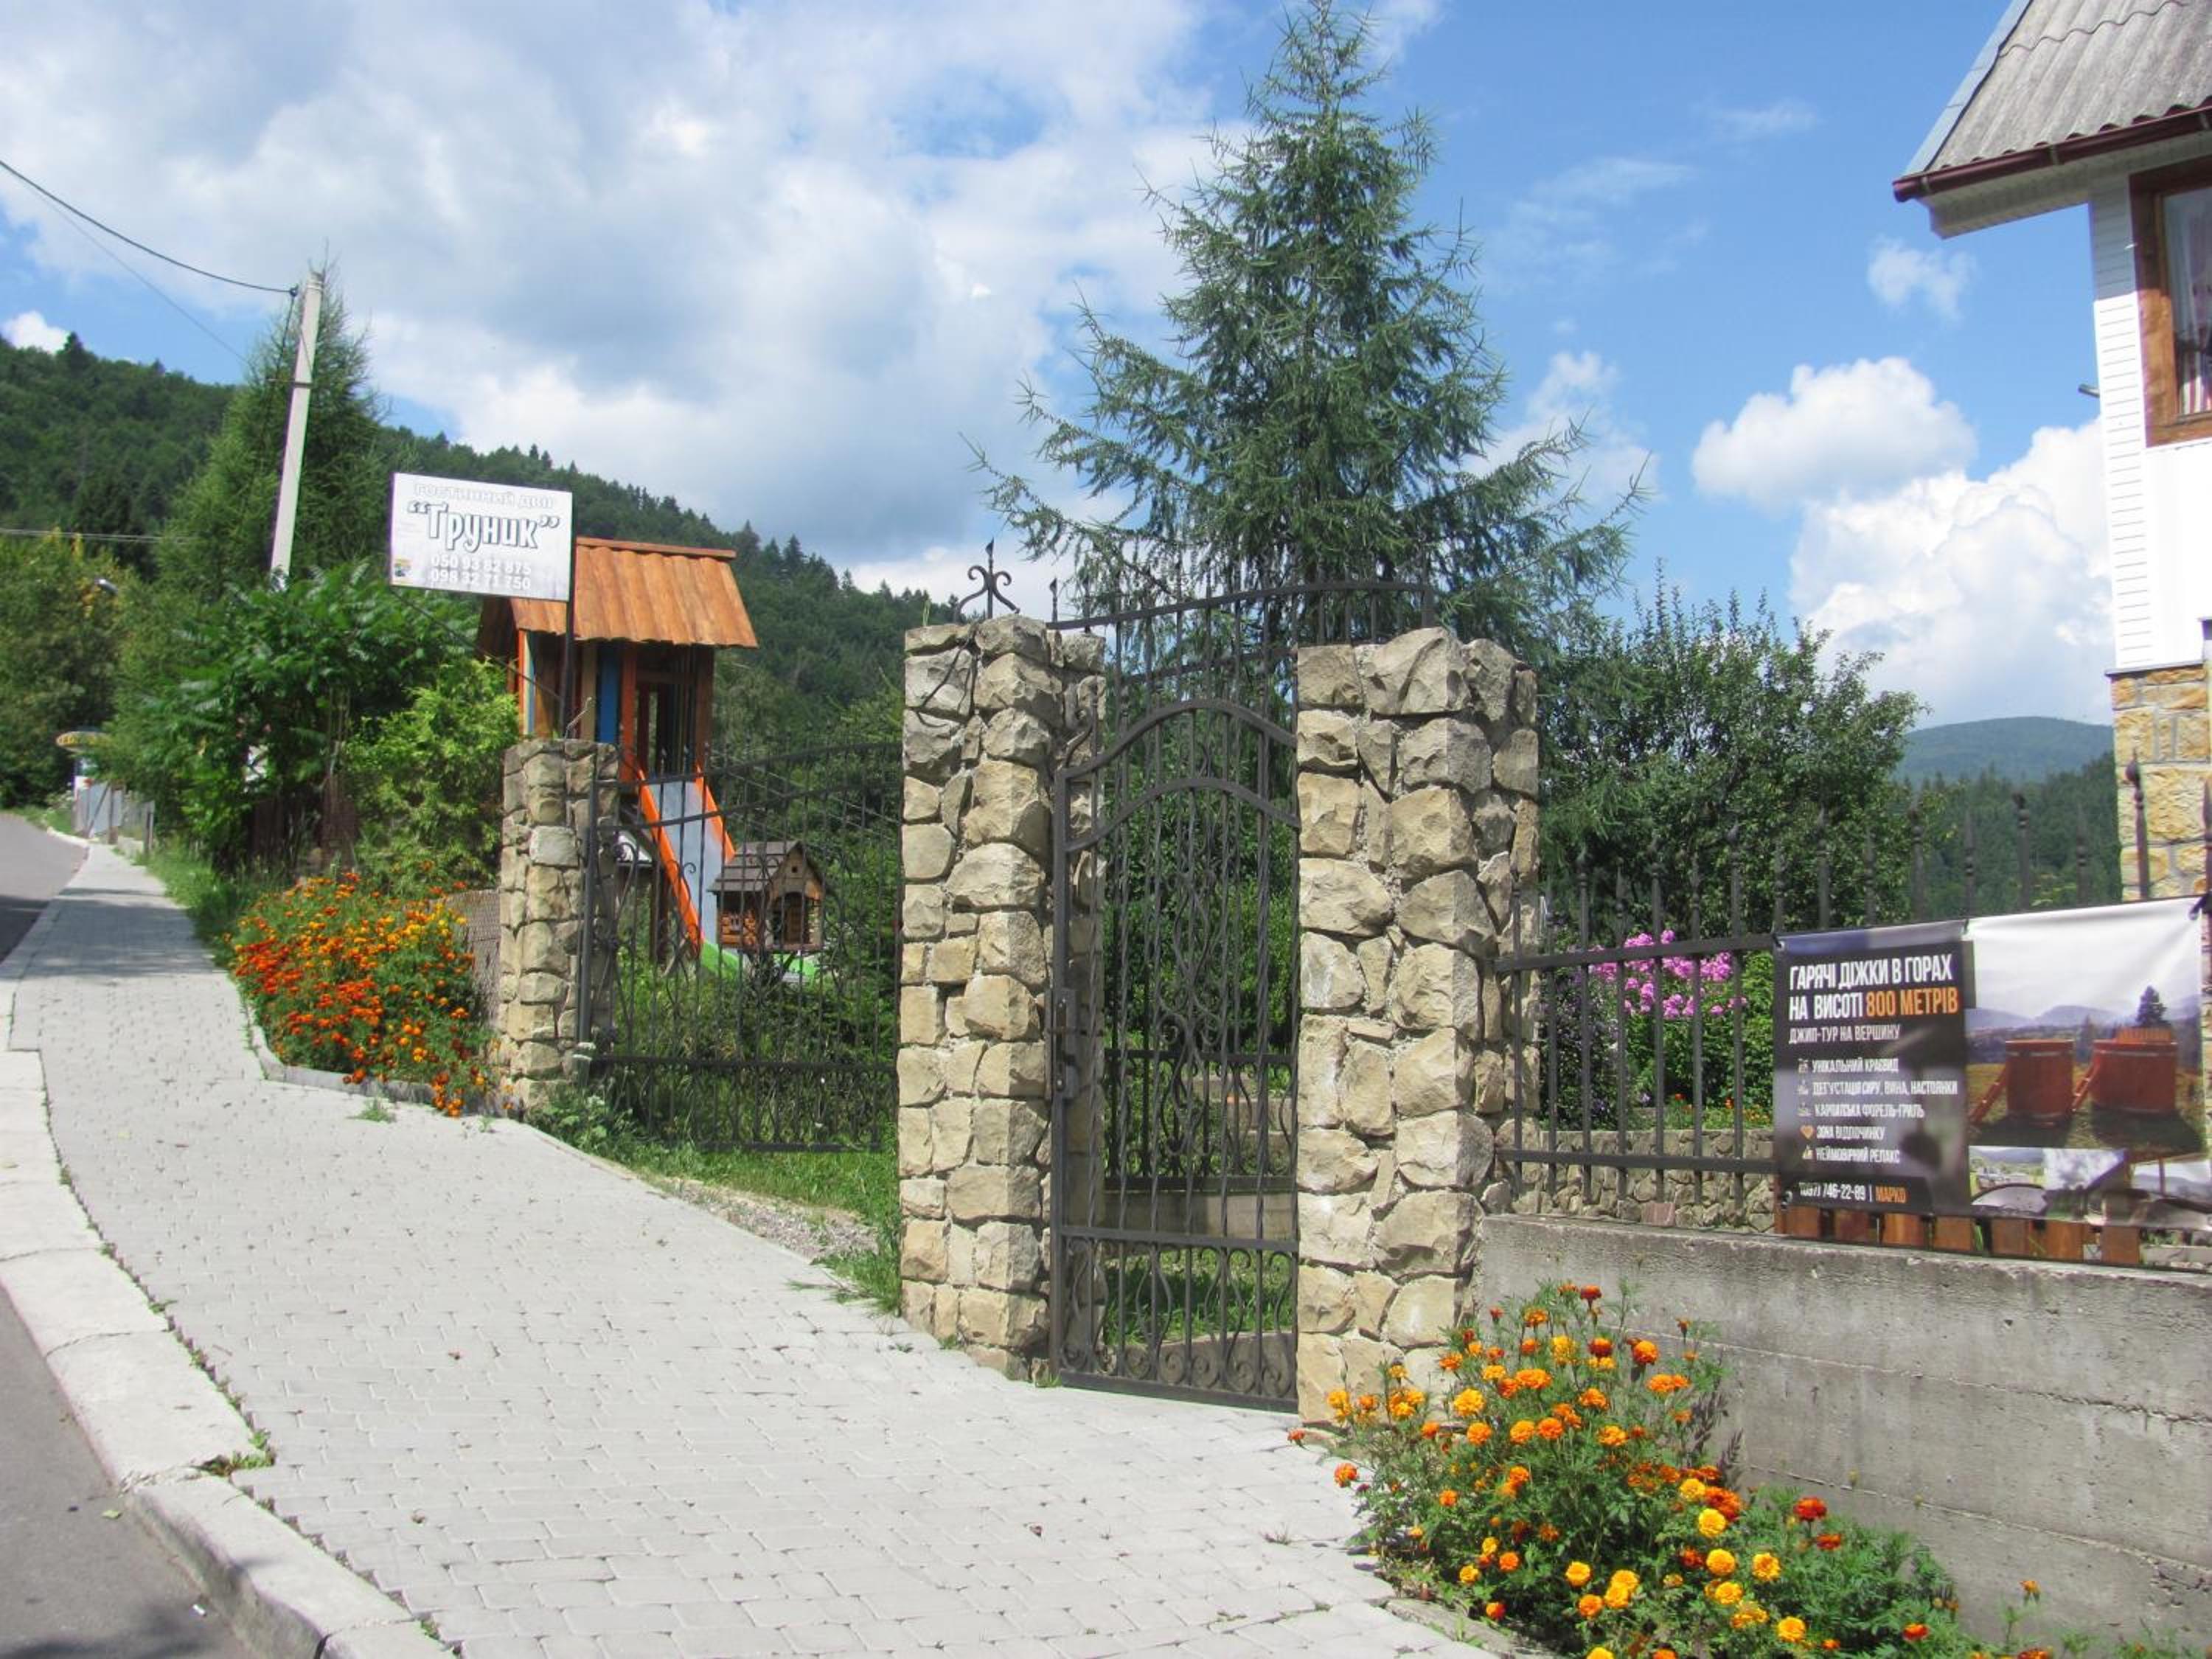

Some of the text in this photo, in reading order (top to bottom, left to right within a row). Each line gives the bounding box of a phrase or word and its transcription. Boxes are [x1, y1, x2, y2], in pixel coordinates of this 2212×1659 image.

[431, 554, 459, 568] 050
[462, 555, 480, 570] 93
[505, 575, 531, 590] 750
[1790, 953, 1952, 990] ГАРЯЧІ ДІЖКИ В ГОРАХ
[1789, 987, 1958, 1020] НА ВИСОТІ 800 МЕТРІВ
[1789, 1023, 1901, 1044] ДЖИП-ТУР НА ВЕРШИНУ
[1812, 1057, 1863, 1074] УНІКАЛЬНИЙ
[1875, 1186, 1907, 1203] МАРКО
